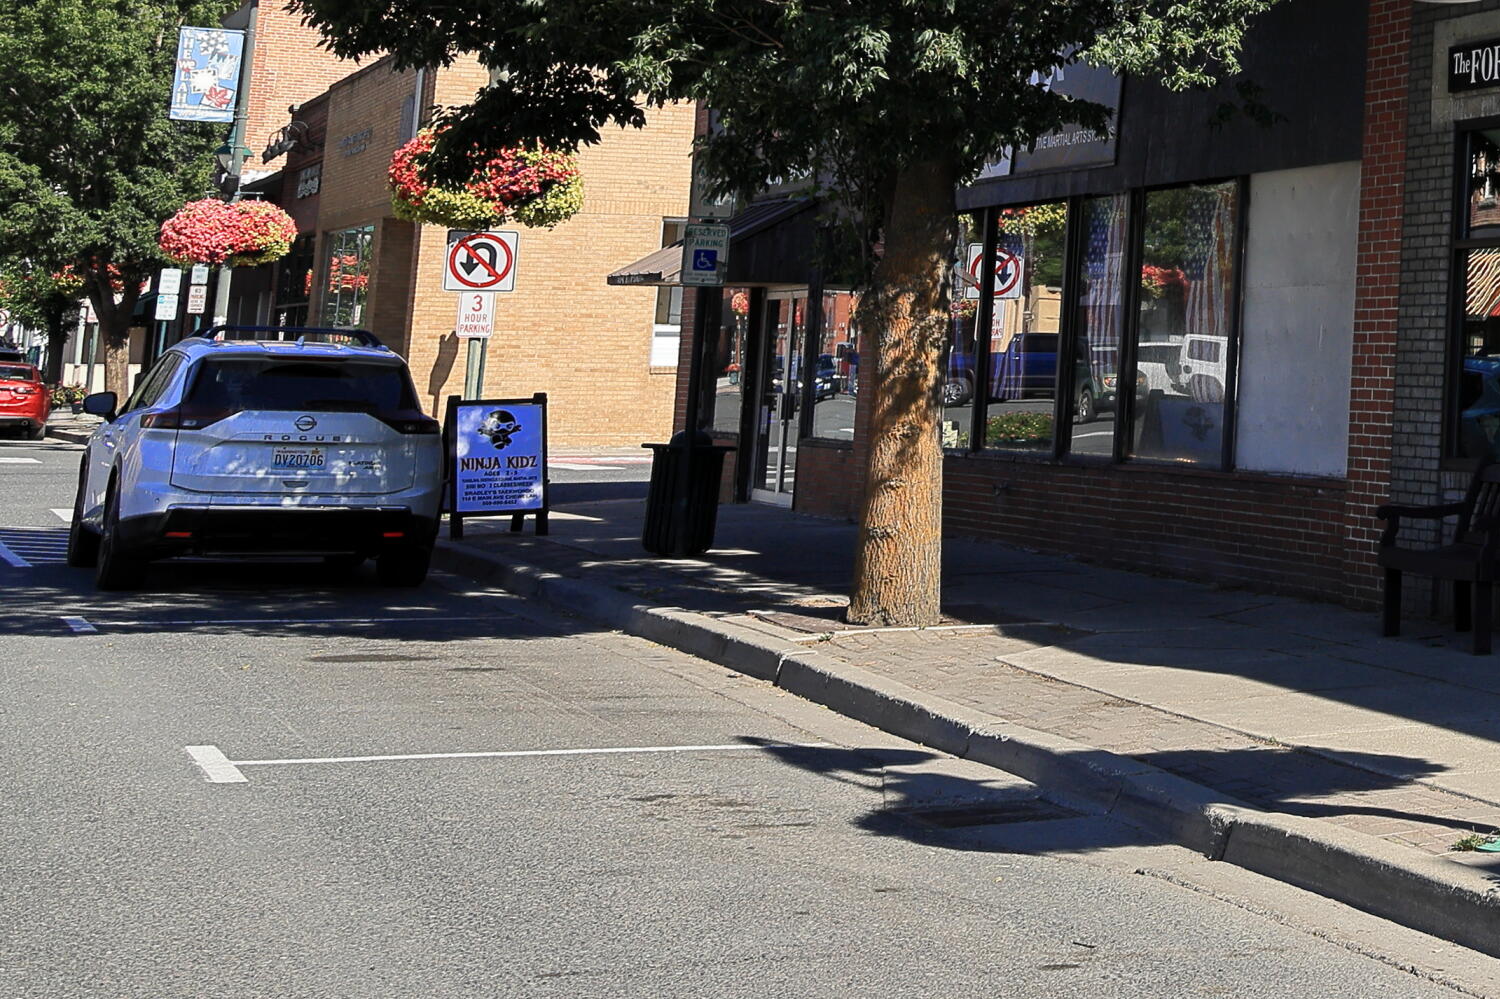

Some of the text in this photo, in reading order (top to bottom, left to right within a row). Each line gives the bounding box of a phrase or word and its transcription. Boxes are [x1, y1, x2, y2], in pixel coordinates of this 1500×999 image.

[1453, 53, 1471, 74] The
[1047, 132, 1072, 147] MARTIAL
[1072, 130, 1087, 144] ARTS
[689, 227, 727, 237] RESERVED
[688, 238, 724, 248] PARKING
[472, 295, 483, 312] 3
[464, 313, 488, 323] HOUR
[460, 324, 490, 334] PARKING
[460, 455, 538, 472] NINJA KIDZ
